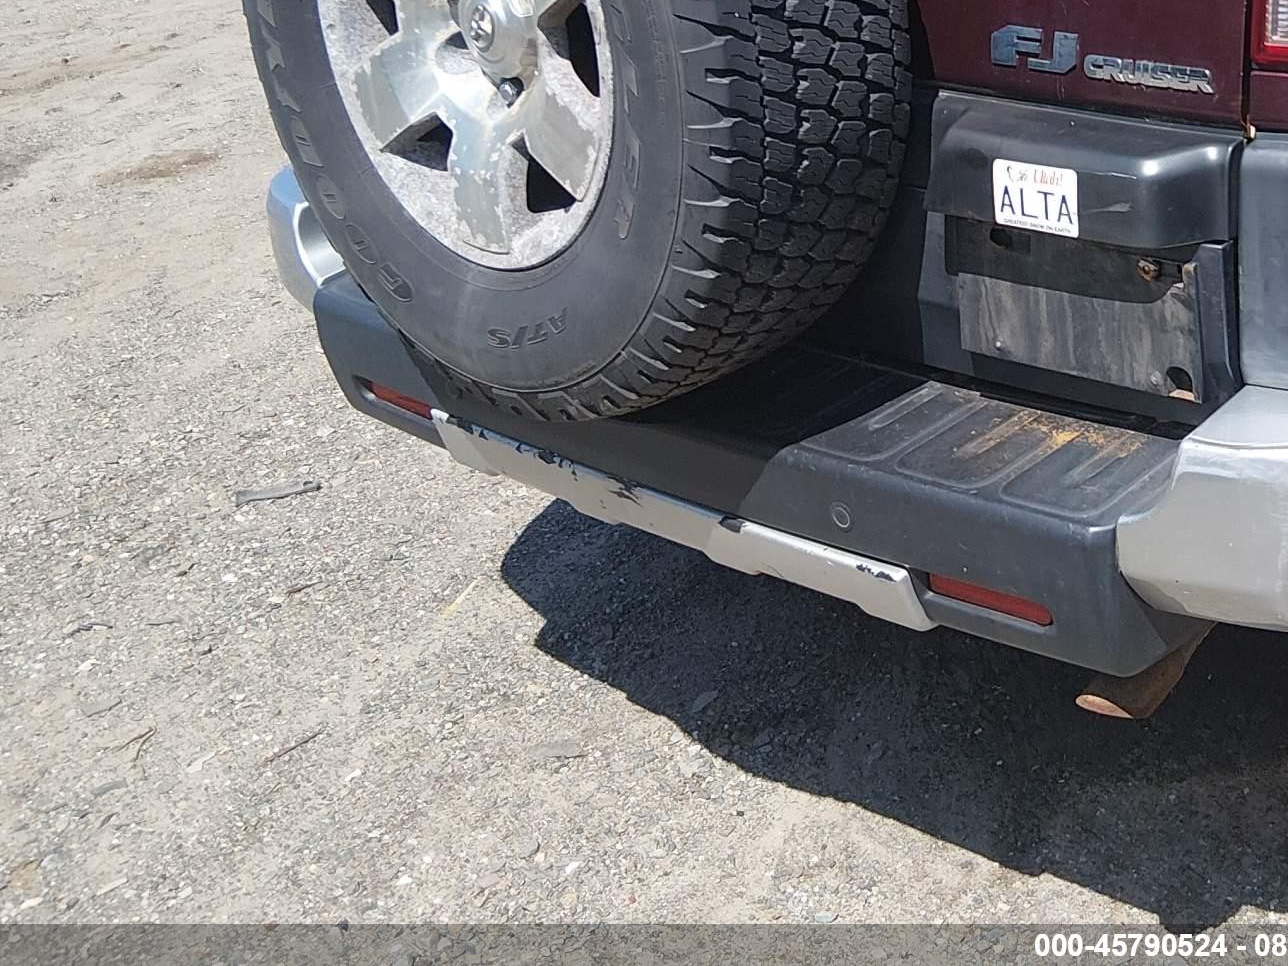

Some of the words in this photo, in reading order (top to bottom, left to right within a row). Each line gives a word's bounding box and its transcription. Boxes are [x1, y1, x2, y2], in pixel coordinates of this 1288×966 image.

[990, 24, 1080, 74] FJ
[1083, 54, 1215, 94] CRUISER
[1000, 185, 1074, 225] ALTA
